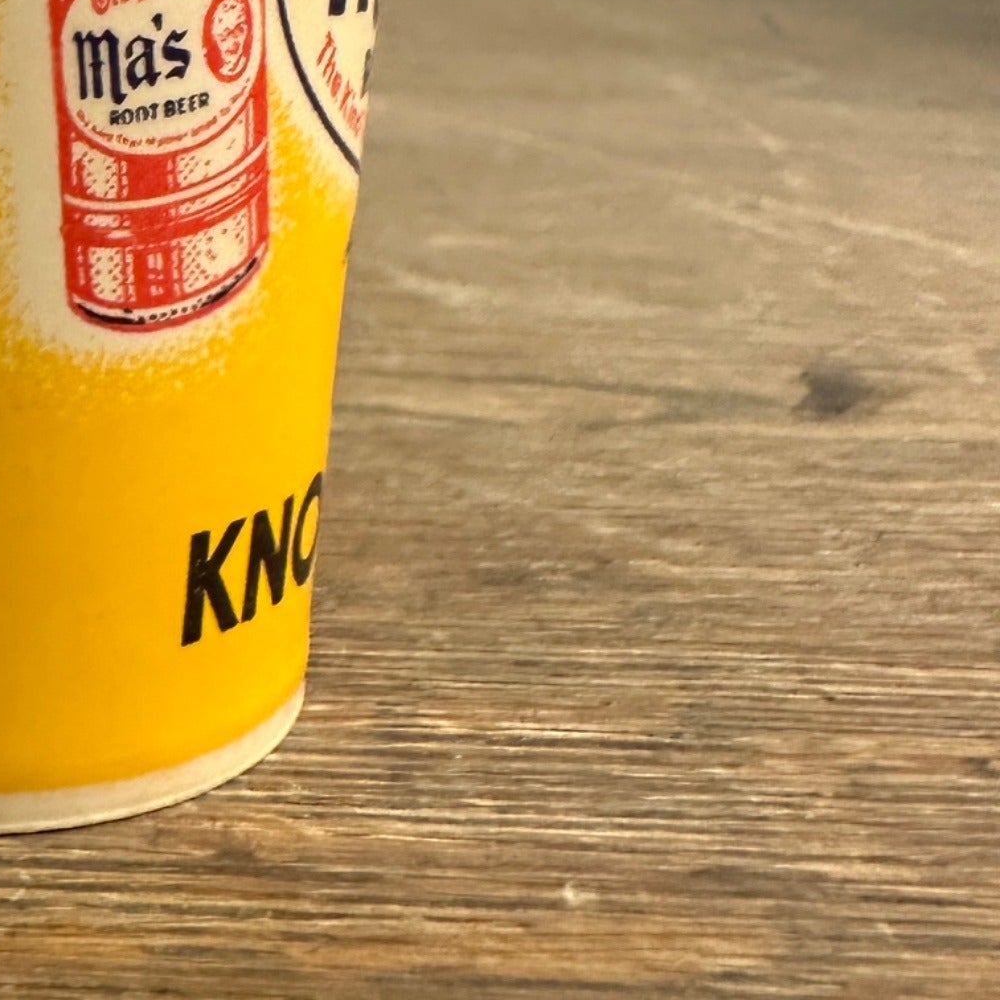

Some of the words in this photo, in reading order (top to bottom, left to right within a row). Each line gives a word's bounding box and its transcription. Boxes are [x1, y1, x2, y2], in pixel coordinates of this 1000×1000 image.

[72, 12, 191, 105] Ma's
[316, 30, 343, 98] The
[109, 102, 160, 126] ROOT
[164, 91, 210, 119] BEER
[180, 471, 324, 647] KNO
